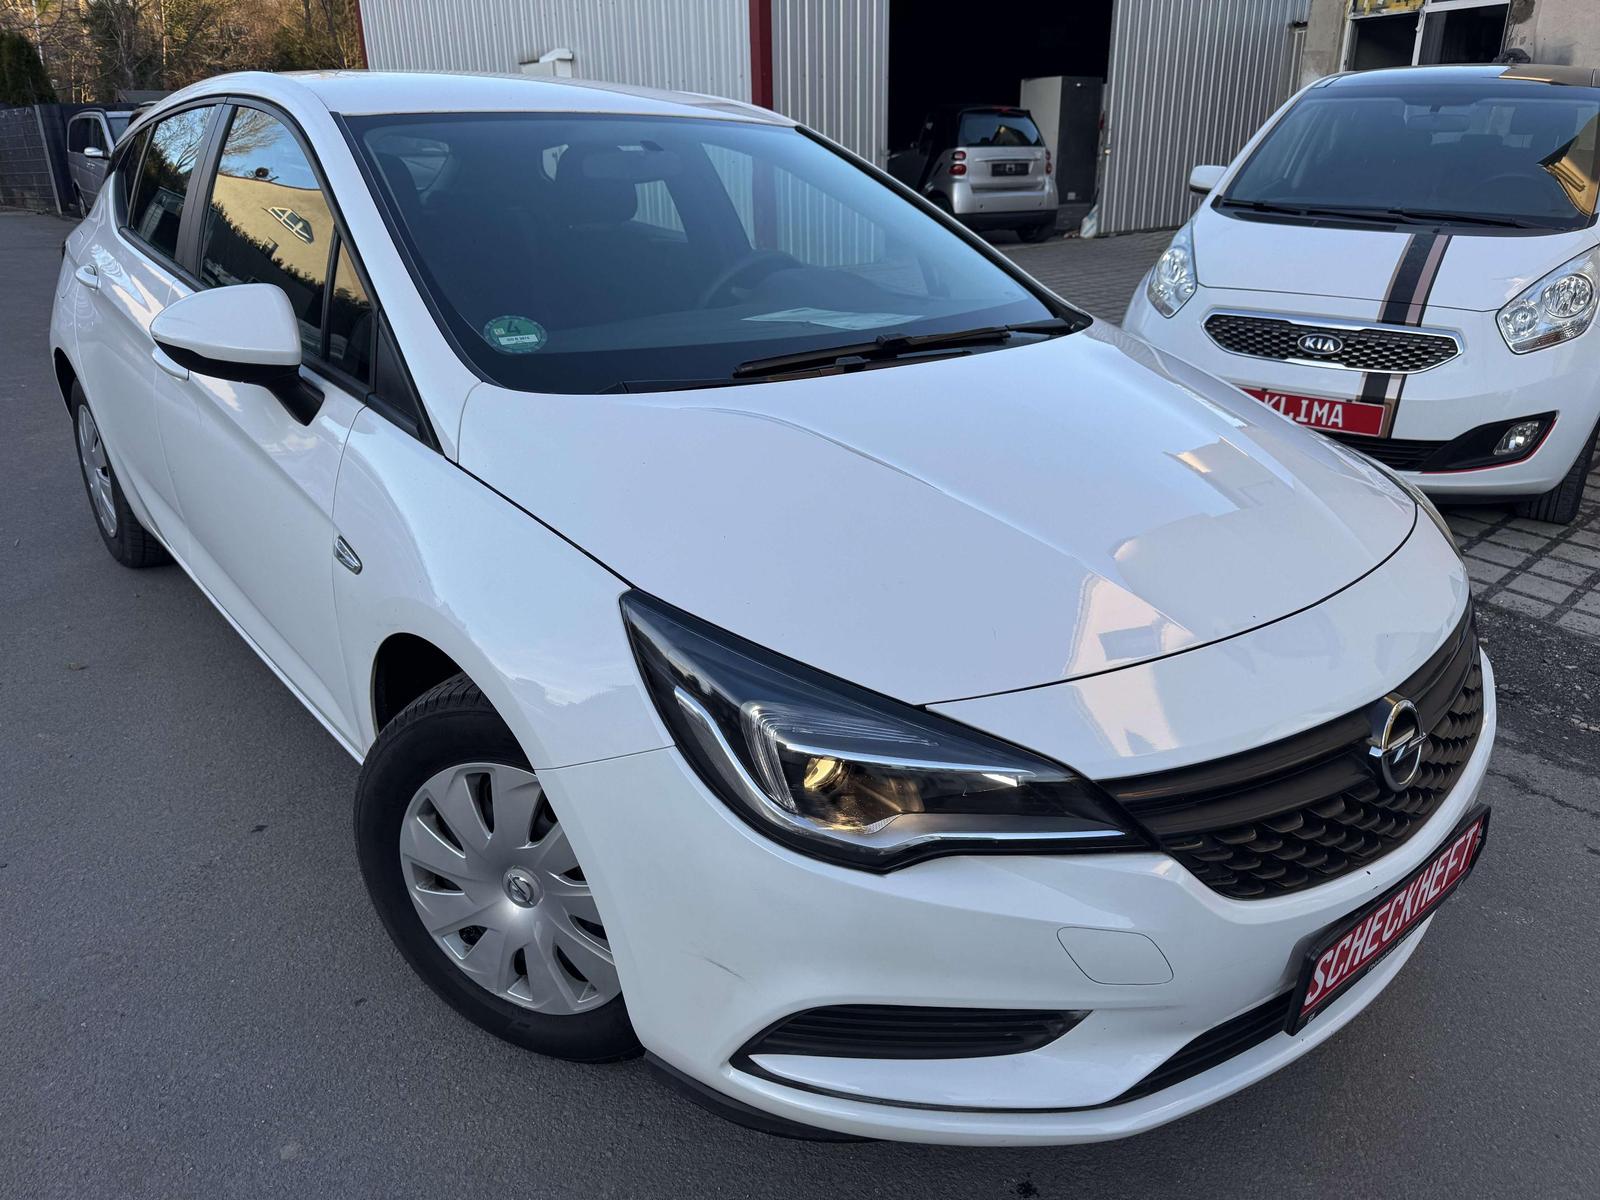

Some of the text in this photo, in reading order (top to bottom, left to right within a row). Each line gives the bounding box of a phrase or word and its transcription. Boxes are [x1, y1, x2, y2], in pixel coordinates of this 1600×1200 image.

[507, 320, 521, 335] 4
[1304, 337, 1335, 351] KIA
[1304, 821, 1479, 1006] SCHECKHEFT
